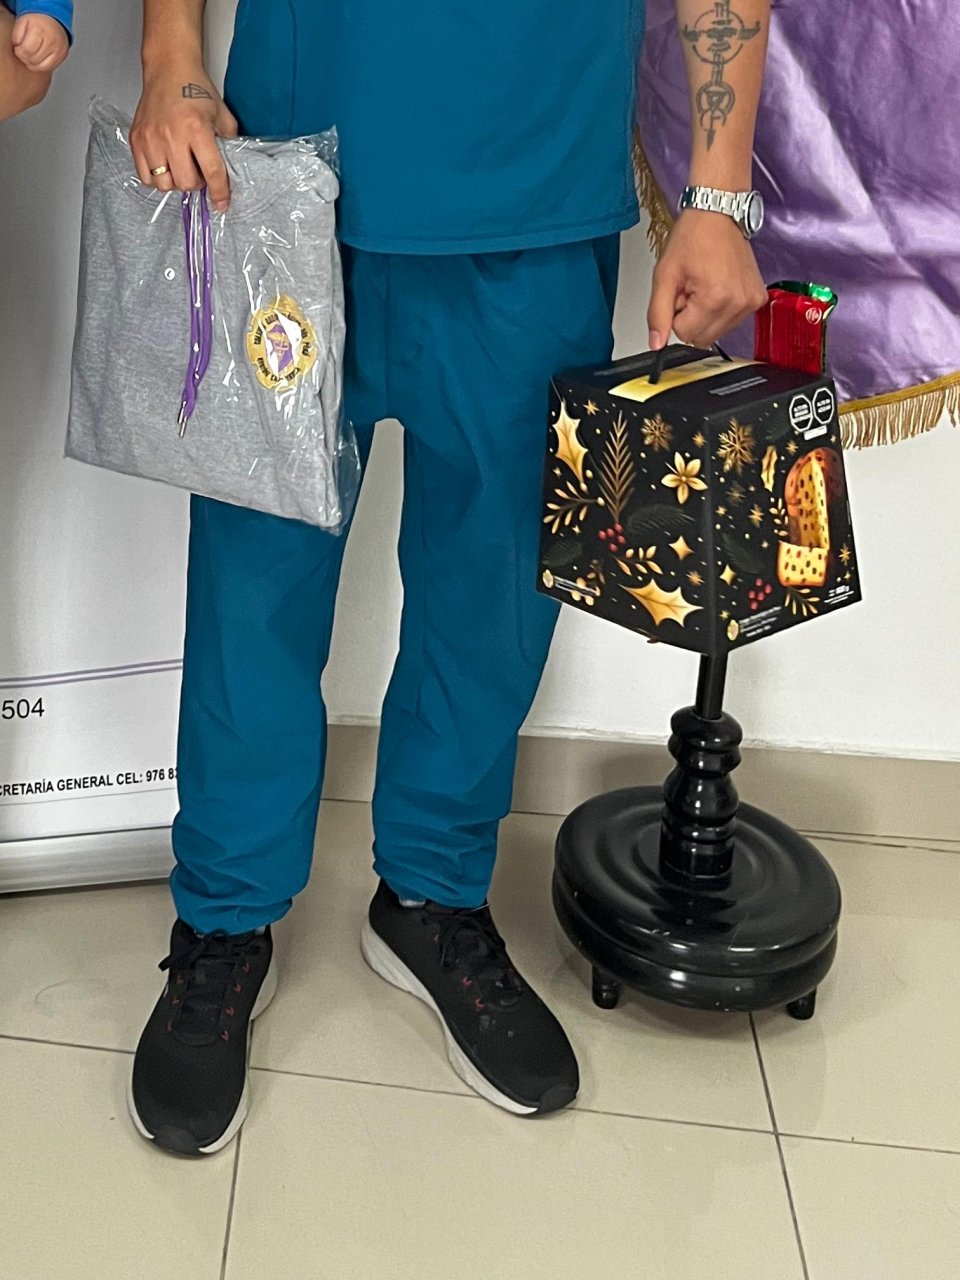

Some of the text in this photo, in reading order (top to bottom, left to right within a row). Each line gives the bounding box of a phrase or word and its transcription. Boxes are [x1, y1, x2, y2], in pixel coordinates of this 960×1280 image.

[1, 697, 45, 720] 504
[57, 775, 113, 791] GENERAL
[116, 772, 143, 785] CEL:
[146, 769, 165, 782] 976
